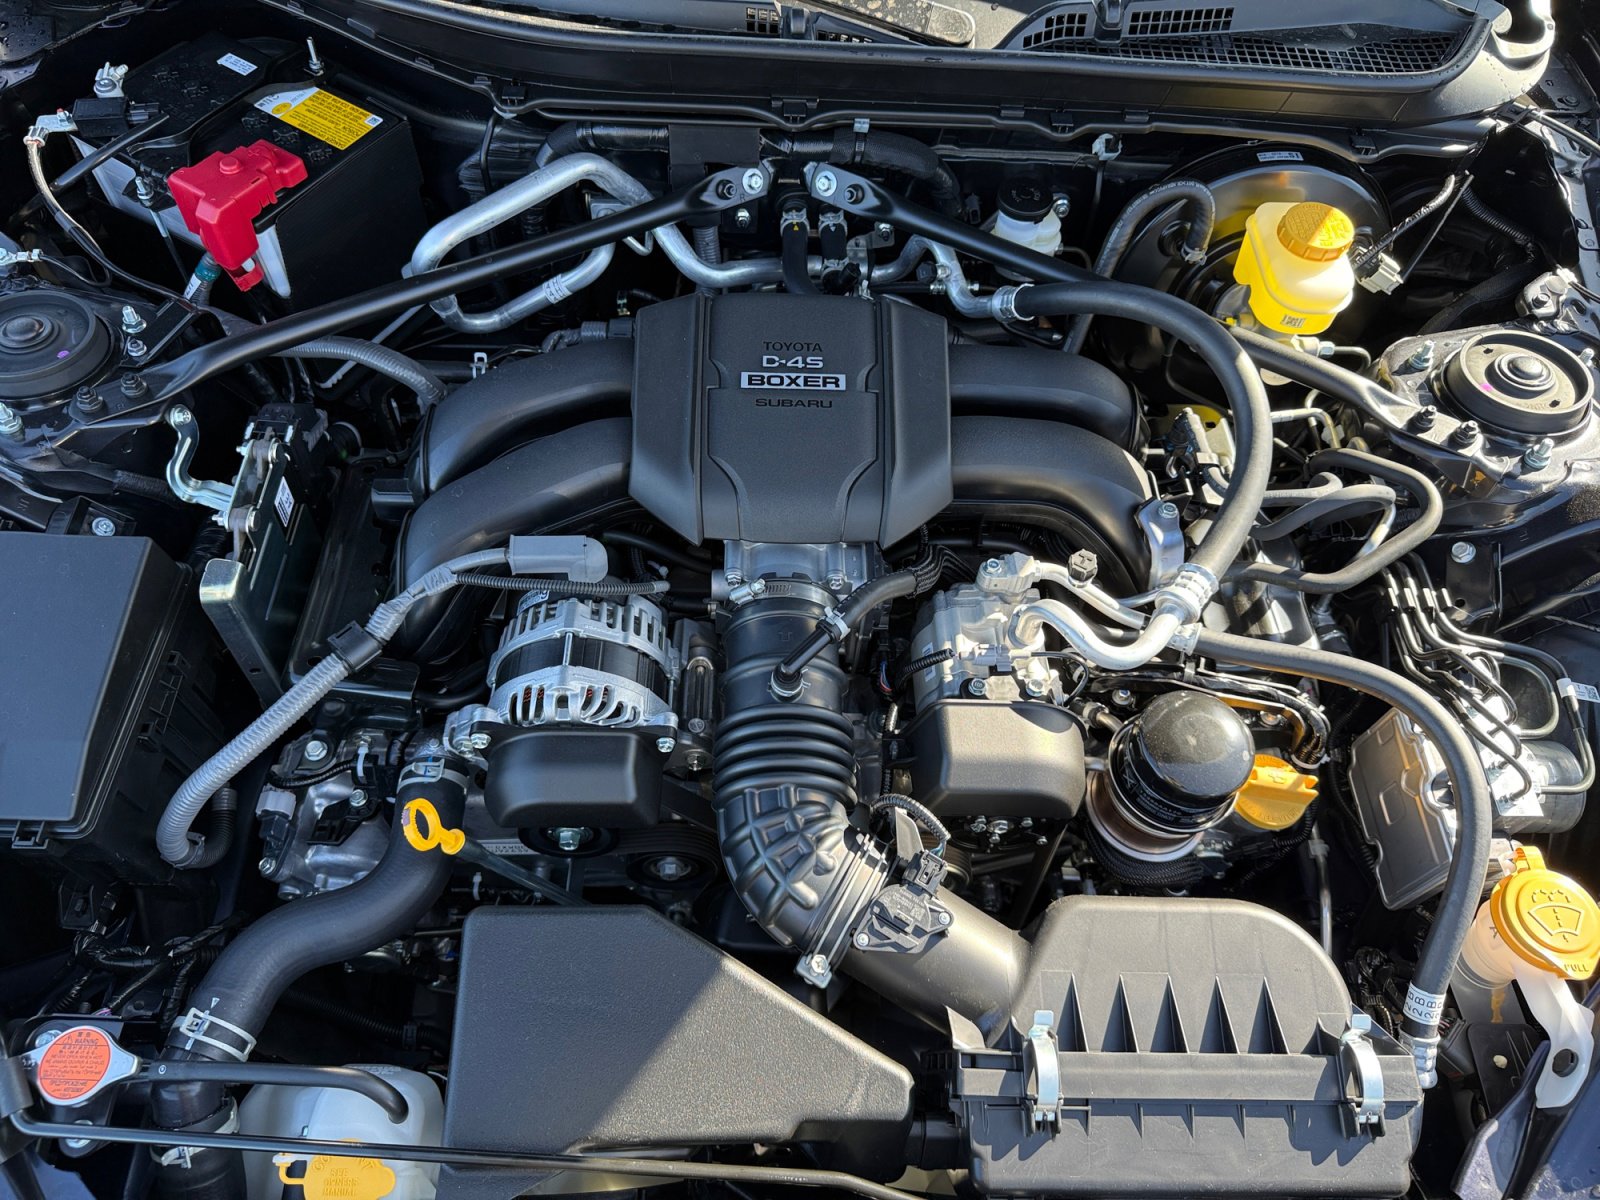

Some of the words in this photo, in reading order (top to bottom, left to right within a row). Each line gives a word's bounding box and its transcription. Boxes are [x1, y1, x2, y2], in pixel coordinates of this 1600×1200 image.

[763, 341, 823, 352] TOYOTA
[762, 355, 824, 369] D-4S
[747, 374, 840, 388] BOXER
[755, 398, 833, 408] SUBARU
[1564, 963, 1590, 972] PULL
